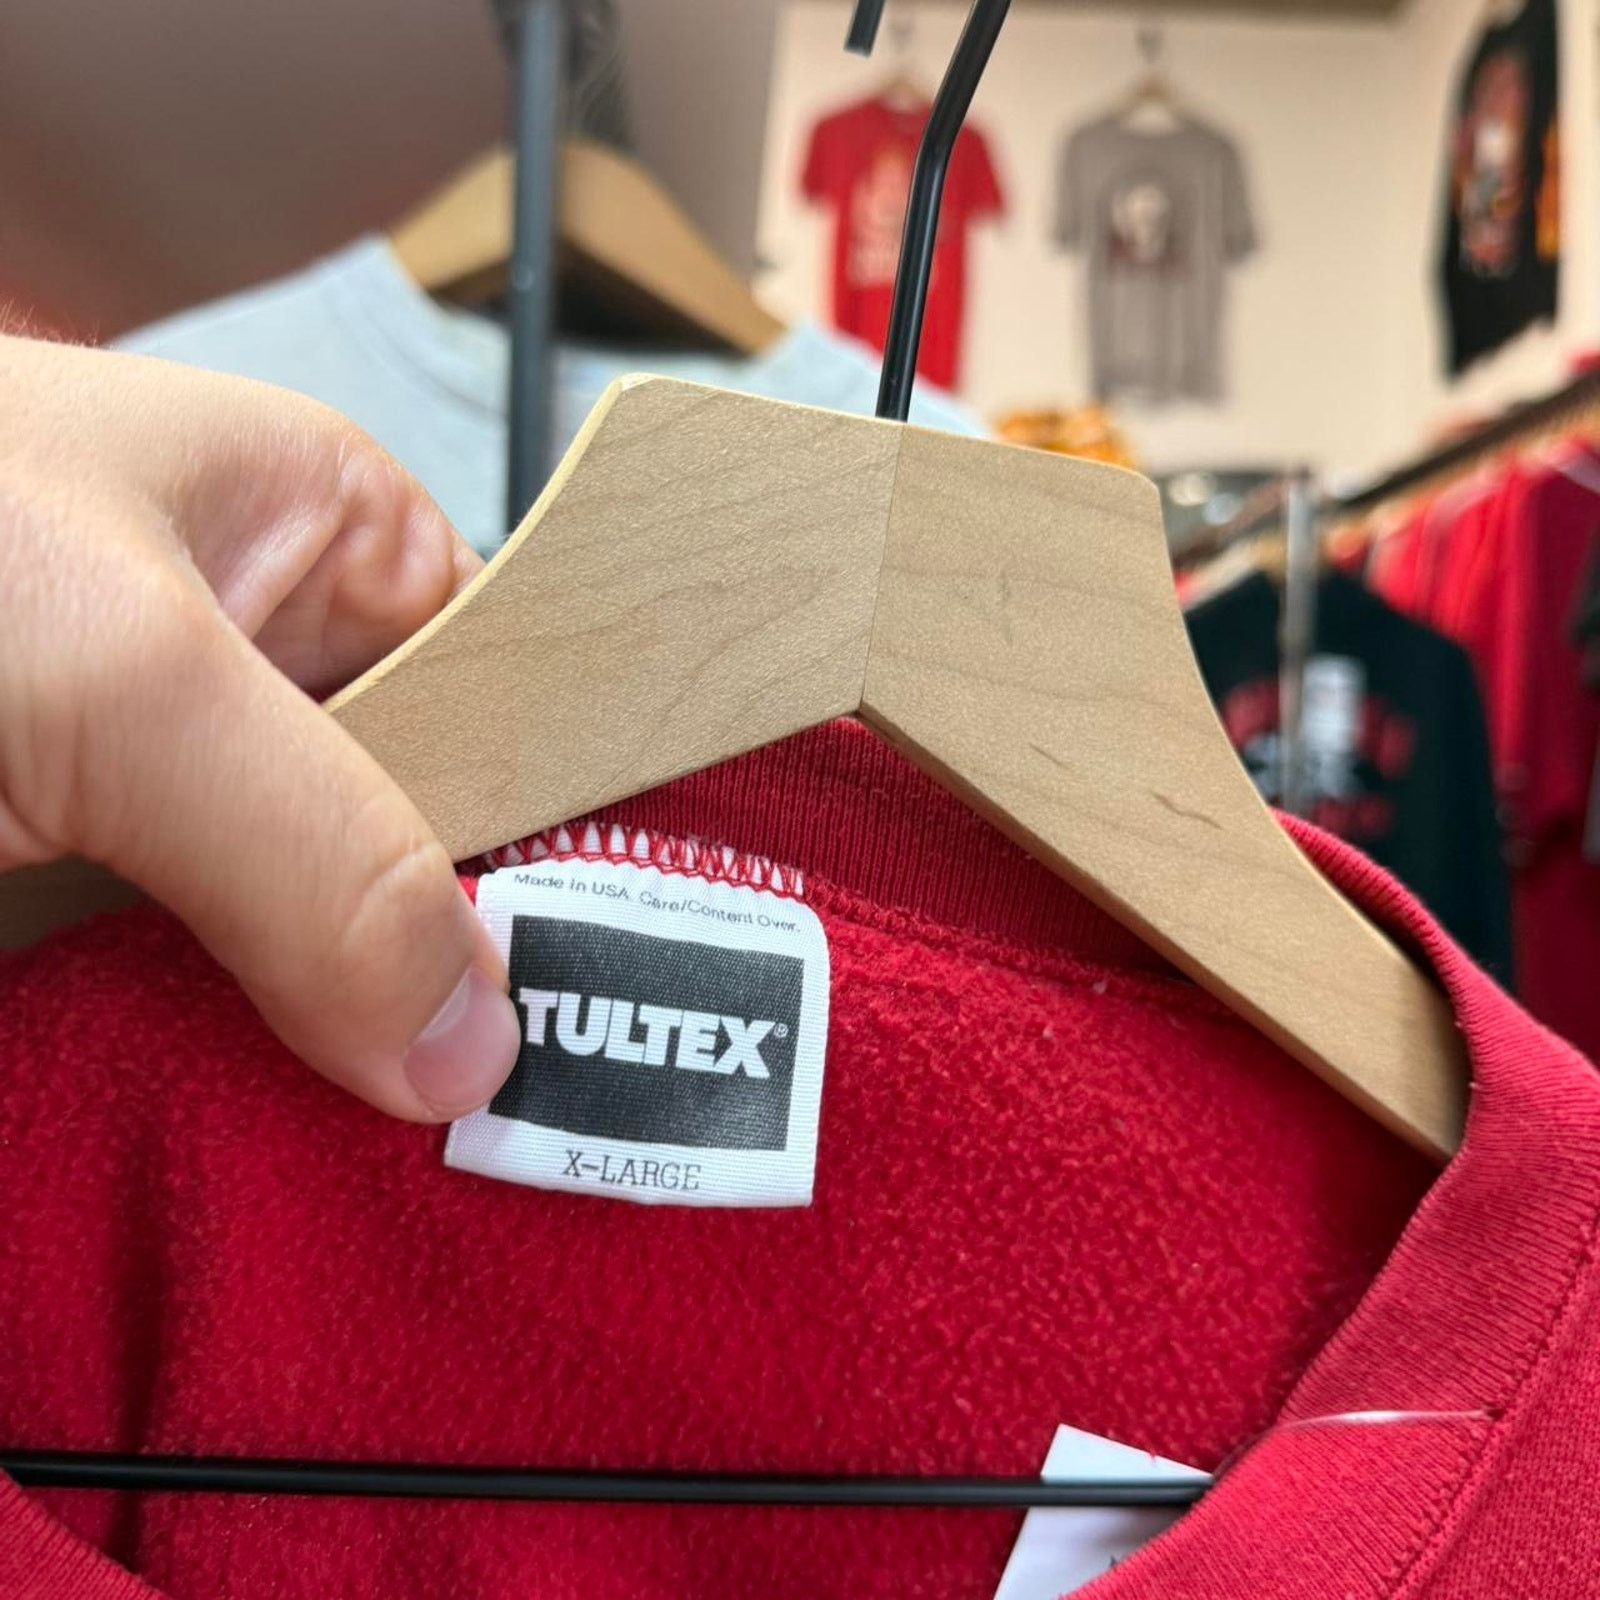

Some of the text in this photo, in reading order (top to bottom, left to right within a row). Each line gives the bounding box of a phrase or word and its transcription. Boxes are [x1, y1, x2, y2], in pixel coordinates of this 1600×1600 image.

[514, 873, 564, 889] Made
[570, 879, 587, 893] in
[562, 1150, 701, 1190] X-LARGE
